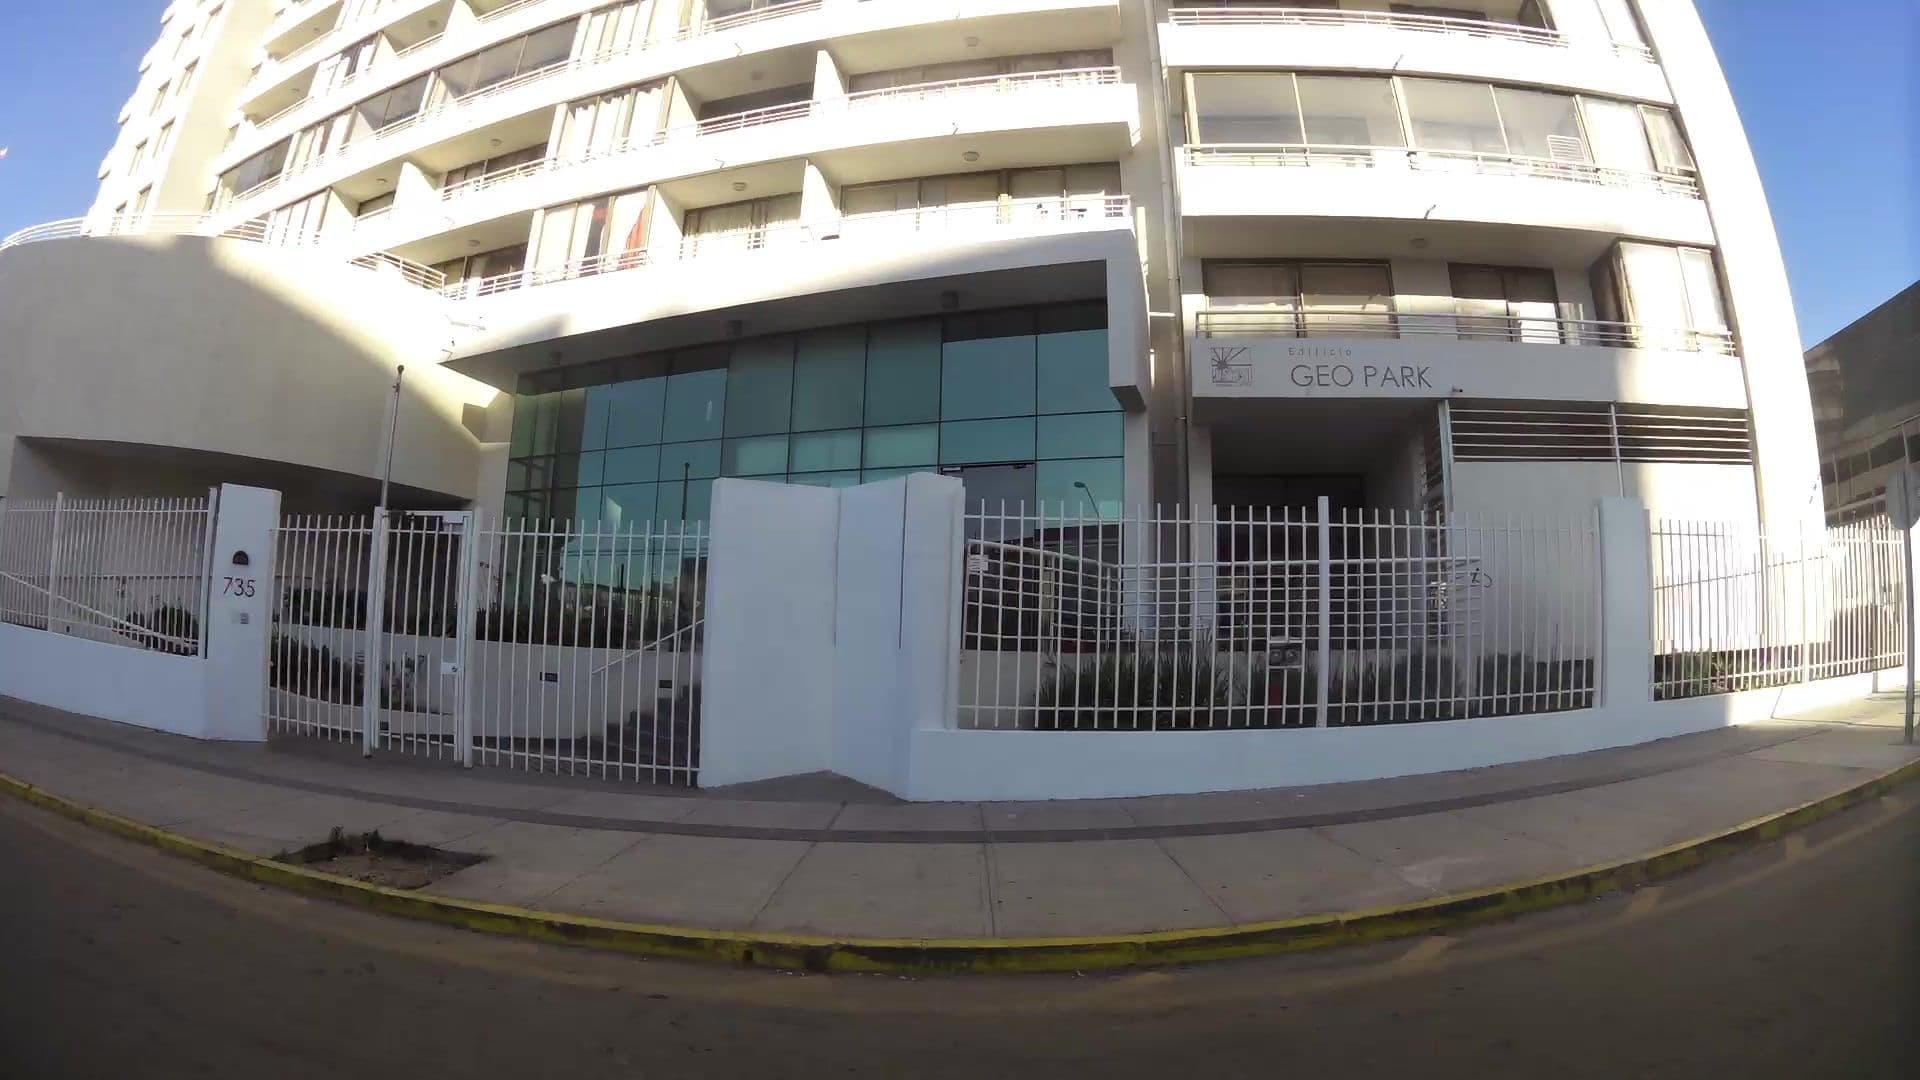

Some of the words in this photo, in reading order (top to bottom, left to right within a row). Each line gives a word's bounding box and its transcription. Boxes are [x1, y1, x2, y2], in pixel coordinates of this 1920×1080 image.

[1290, 364, 1354, 387] GEO
[1363, 365, 1432, 388] PARK
[223, 576, 256, 597] 735
